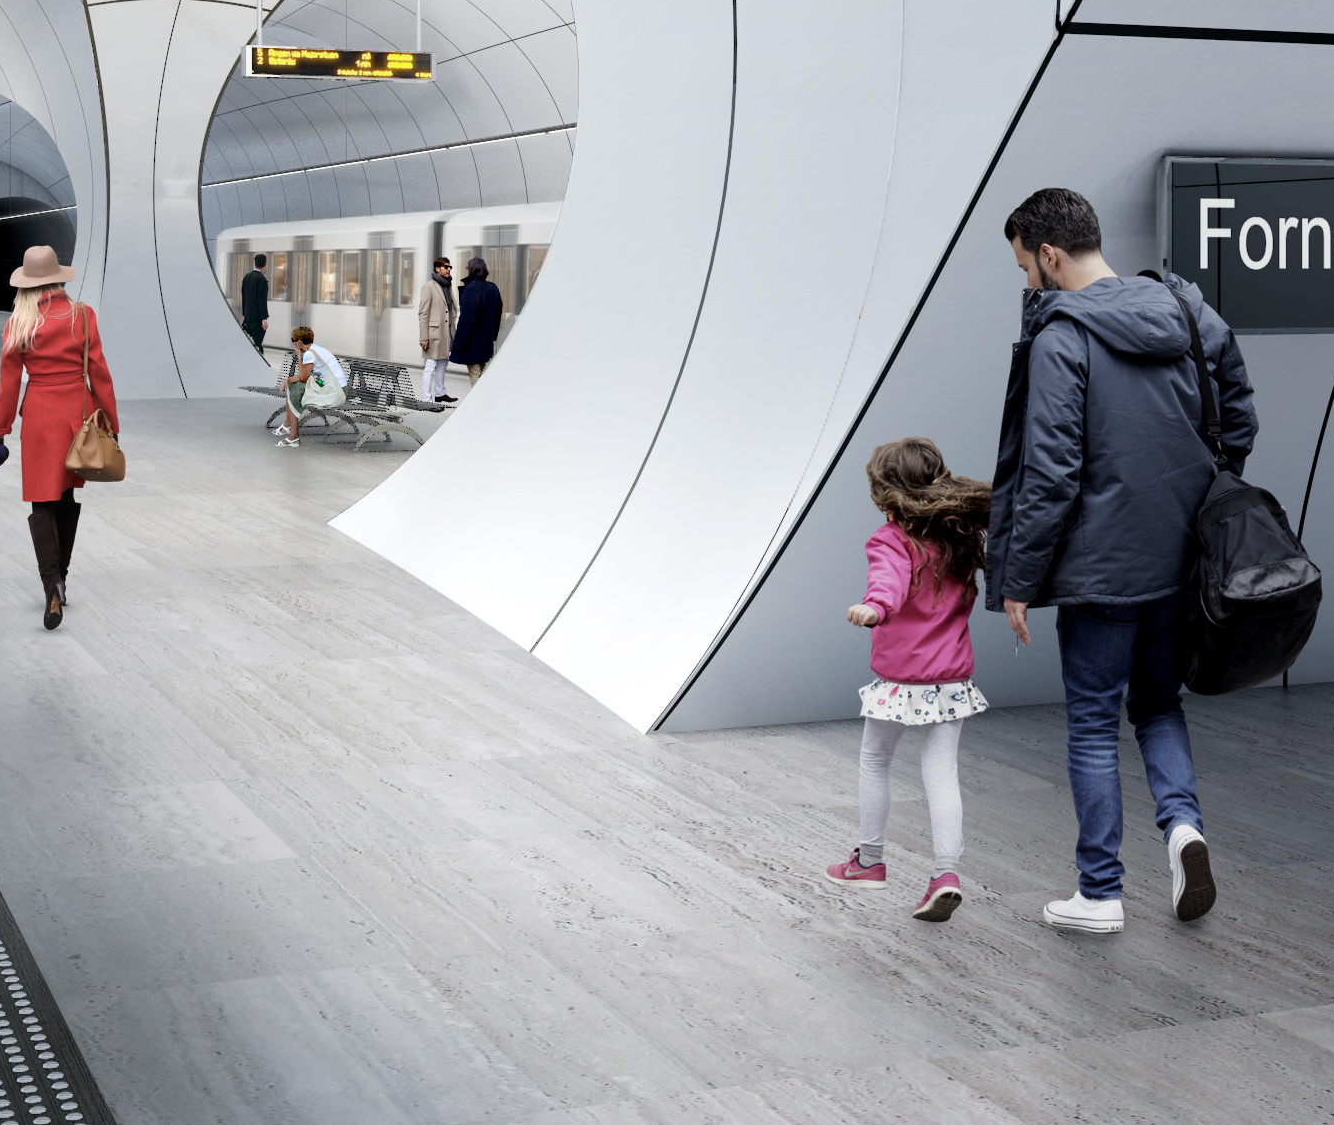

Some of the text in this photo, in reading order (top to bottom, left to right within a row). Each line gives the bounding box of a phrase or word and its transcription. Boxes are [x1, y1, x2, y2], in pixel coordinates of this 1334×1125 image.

[256, 48, 264, 57] 5
[301, 50, 340, 60] Majorstuen
[257, 57, 264, 65] 2
